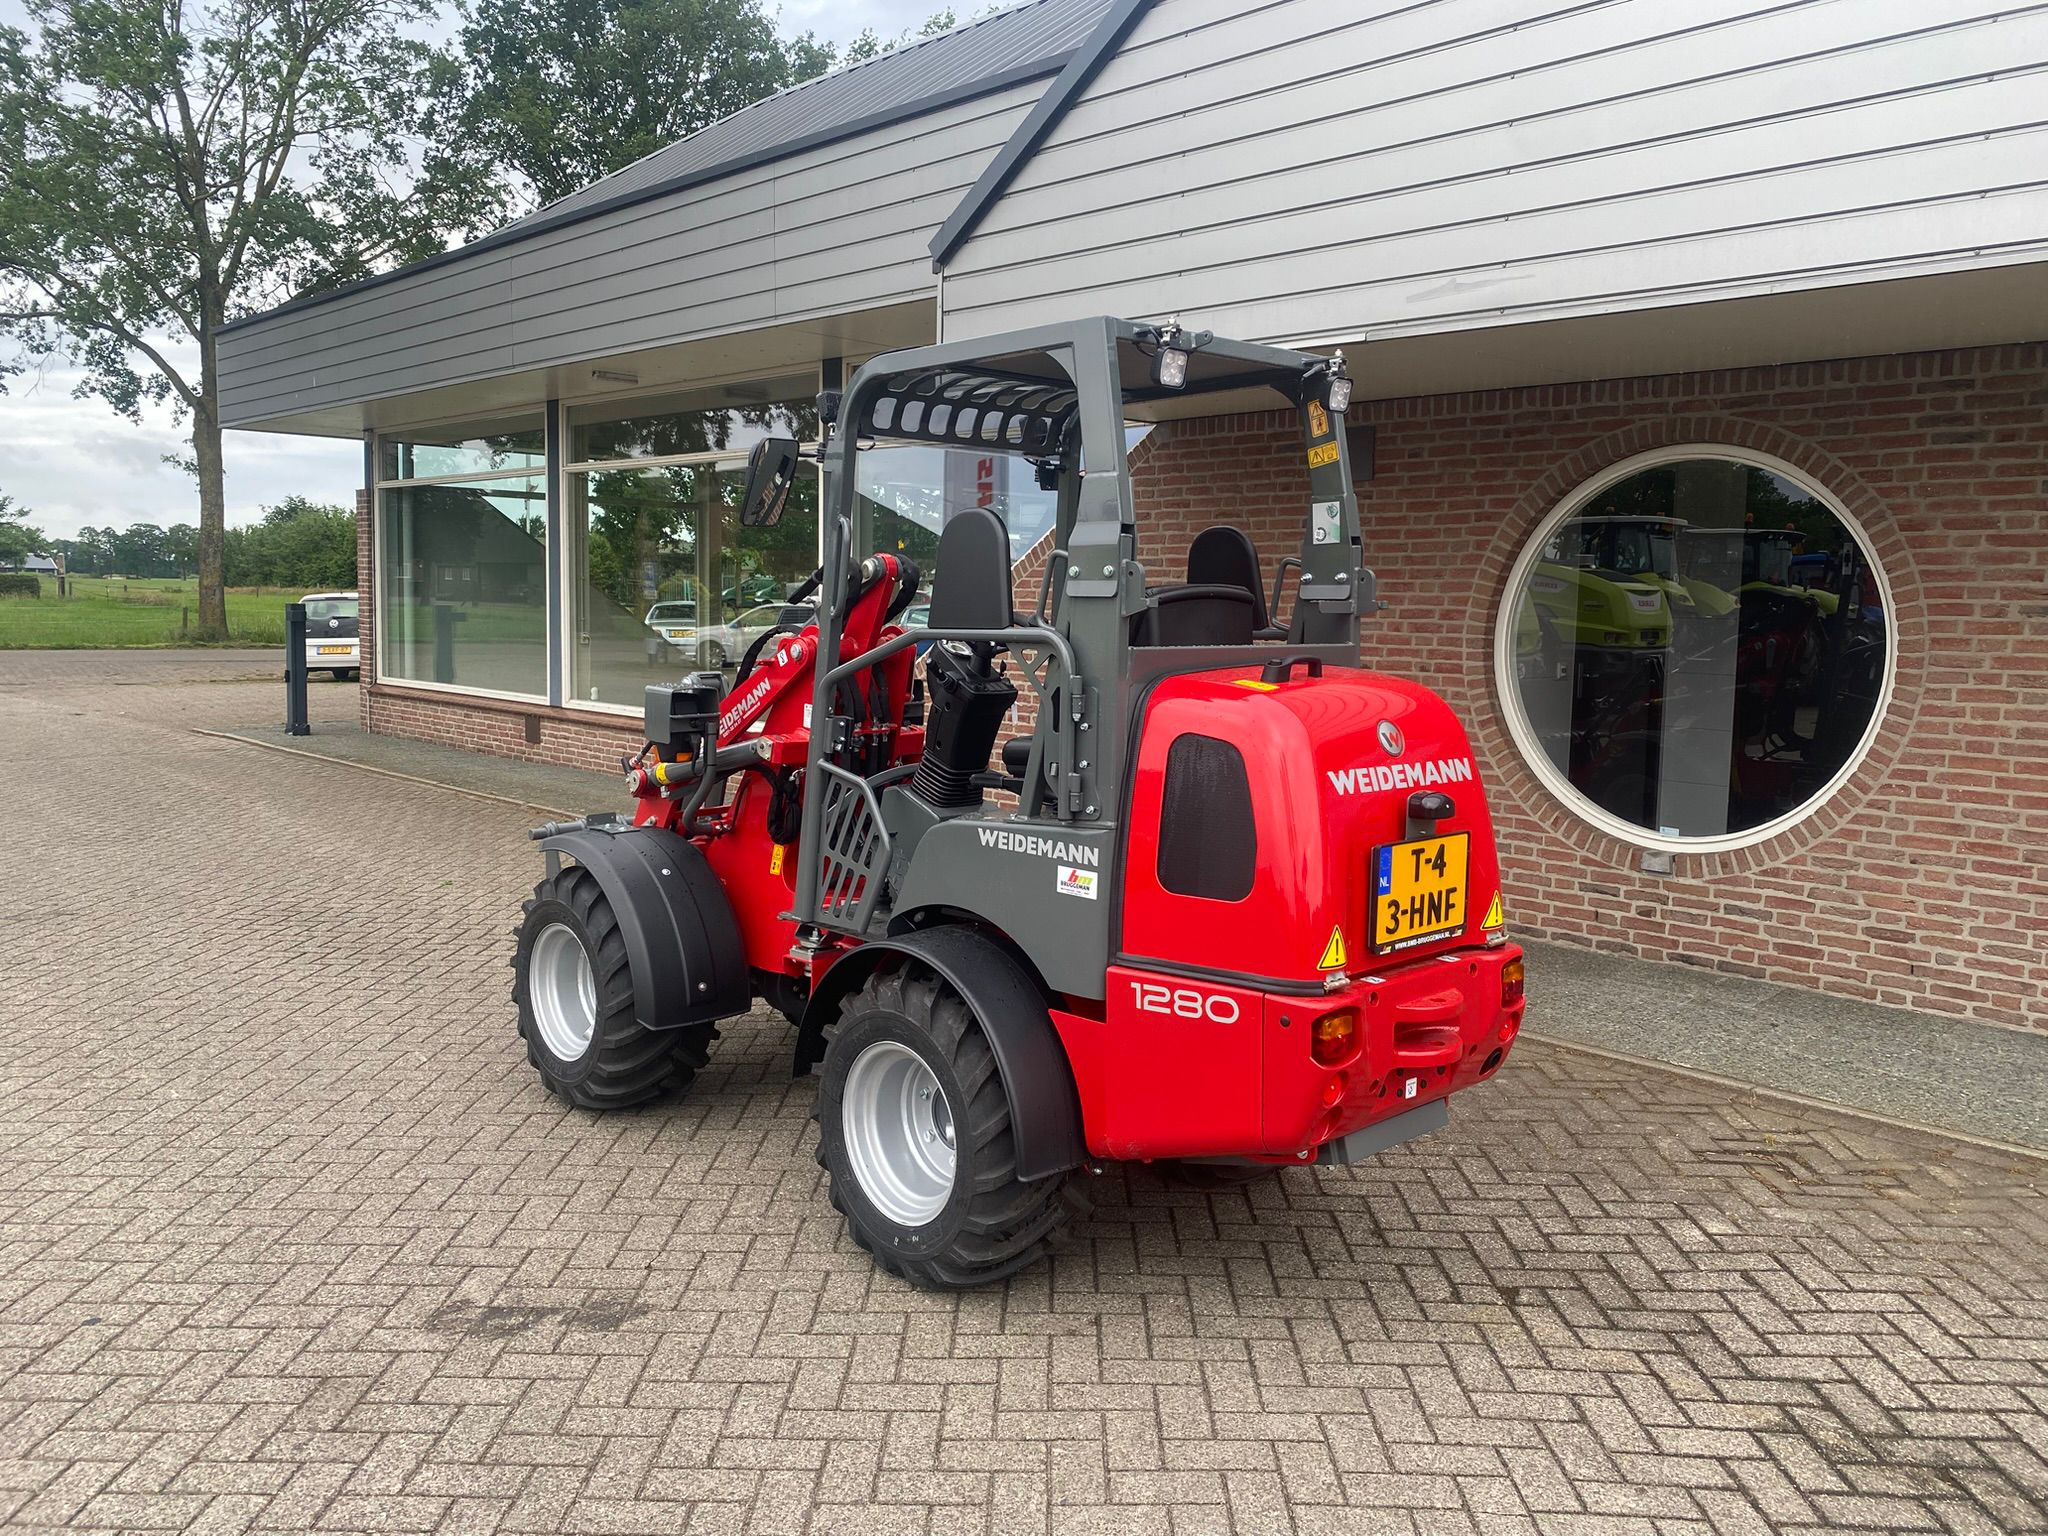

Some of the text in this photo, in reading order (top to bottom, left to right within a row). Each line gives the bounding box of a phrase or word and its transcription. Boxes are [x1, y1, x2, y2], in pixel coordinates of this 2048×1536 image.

[719, 676, 771, 735] EIDEMANN
[1327, 757, 1473, 796] WEIDEMANN
[977, 827, 1099, 867] WEIDEMANN
[1411, 843, 1447, 883] T-4
[1060, 879, 1091, 892] BRUGGEMAN
[1379, 876, 1390, 888] NL
[1385, 886, 1458, 935] 3-HNF
[1130, 981, 1240, 1024] 1280
